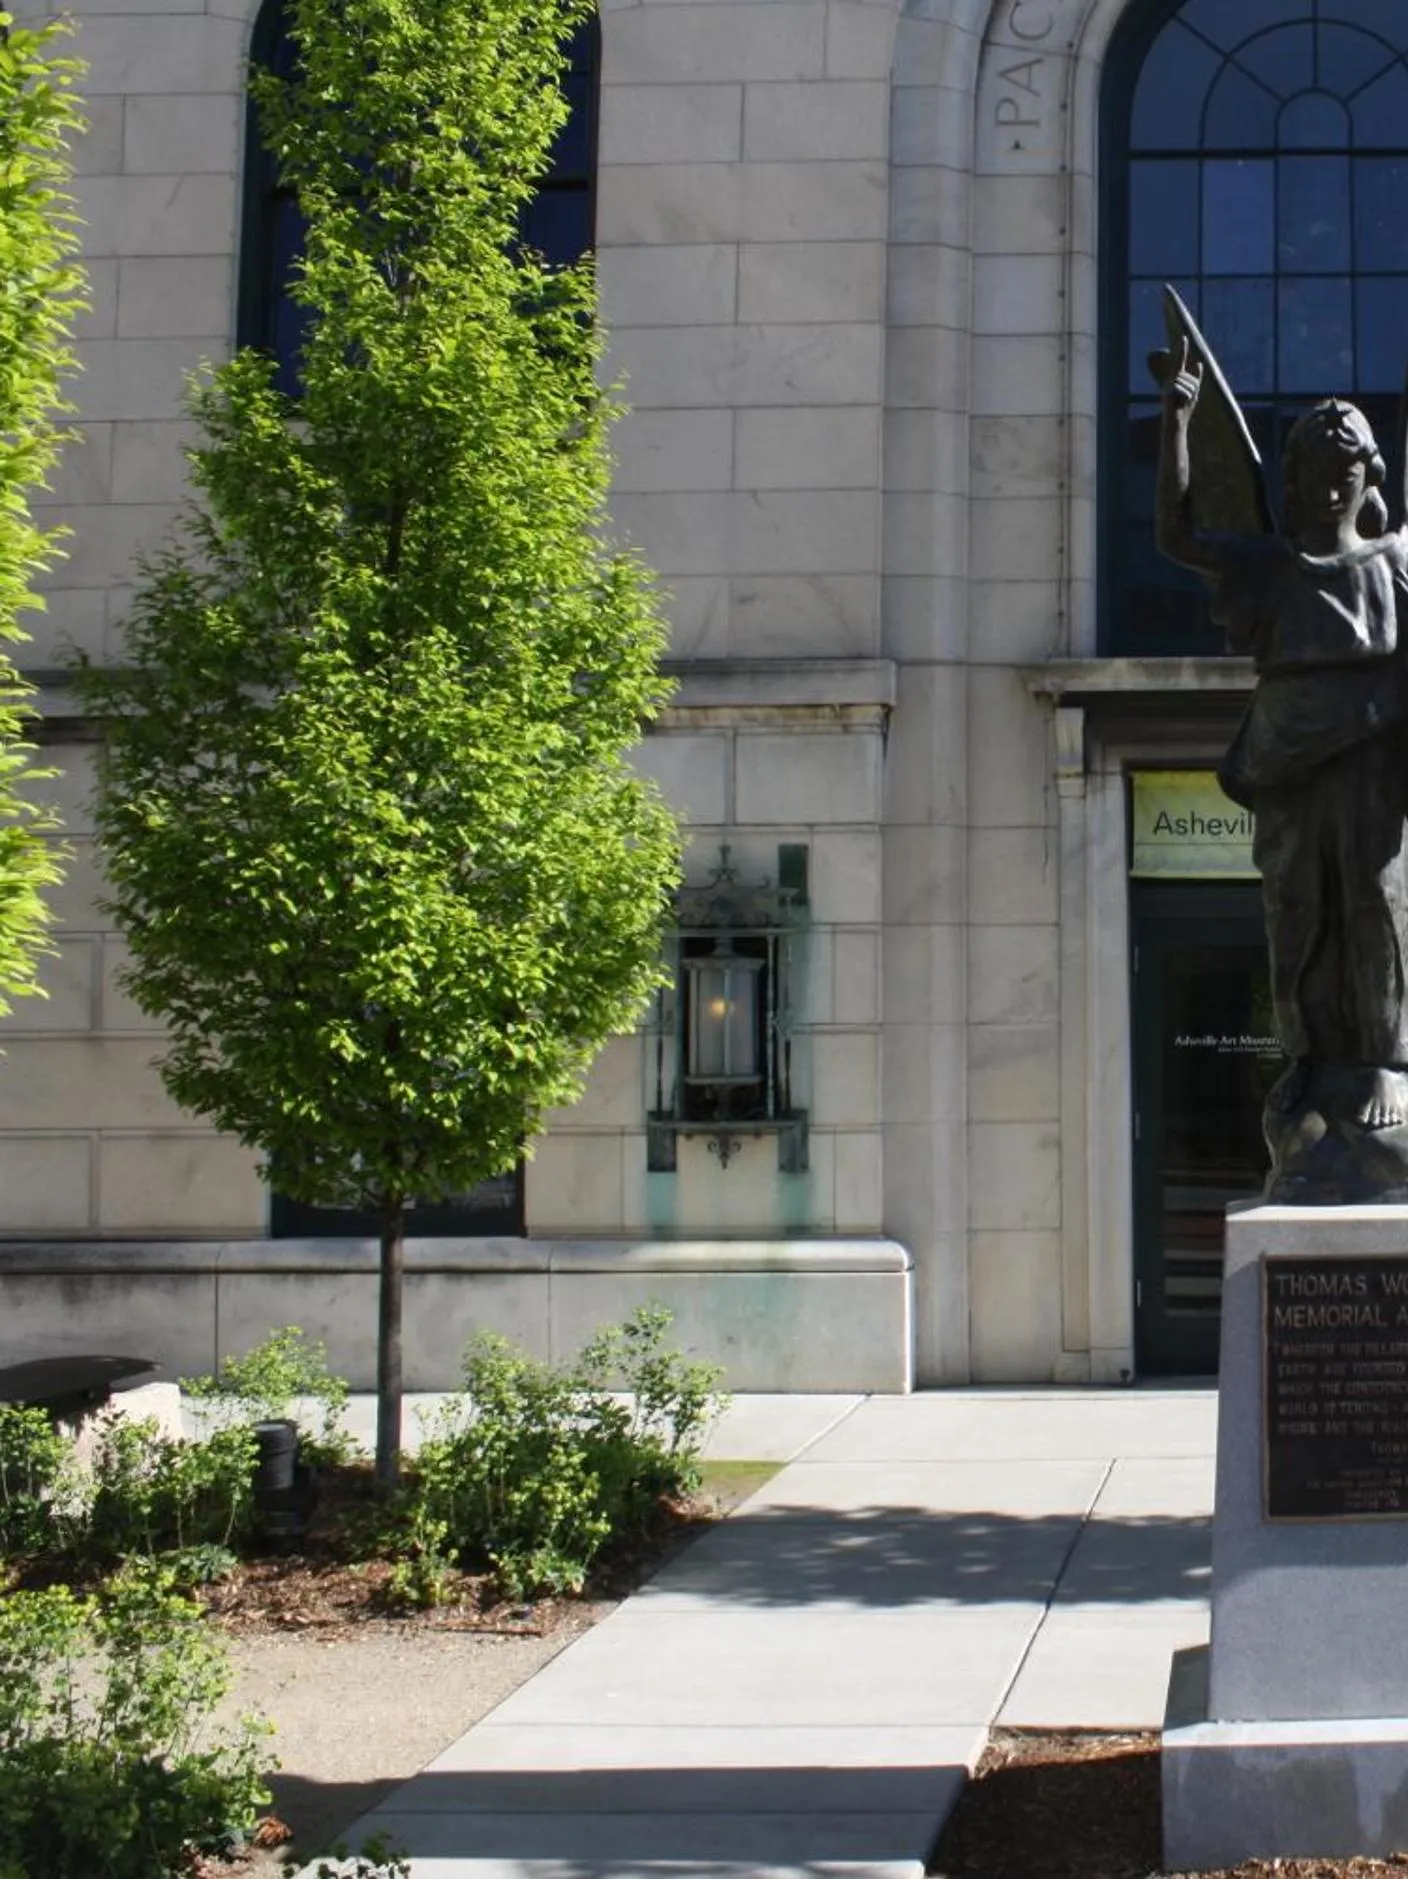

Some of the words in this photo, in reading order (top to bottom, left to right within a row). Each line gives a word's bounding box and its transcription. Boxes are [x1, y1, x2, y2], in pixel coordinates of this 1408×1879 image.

[994, 0, 1055, 129] PAC
[1152, 810, 1254, 836] Ashevil
[1274, 1272, 1368, 1297] THOMAS
[1273, 1303, 1388, 1329] MEMORIAL
